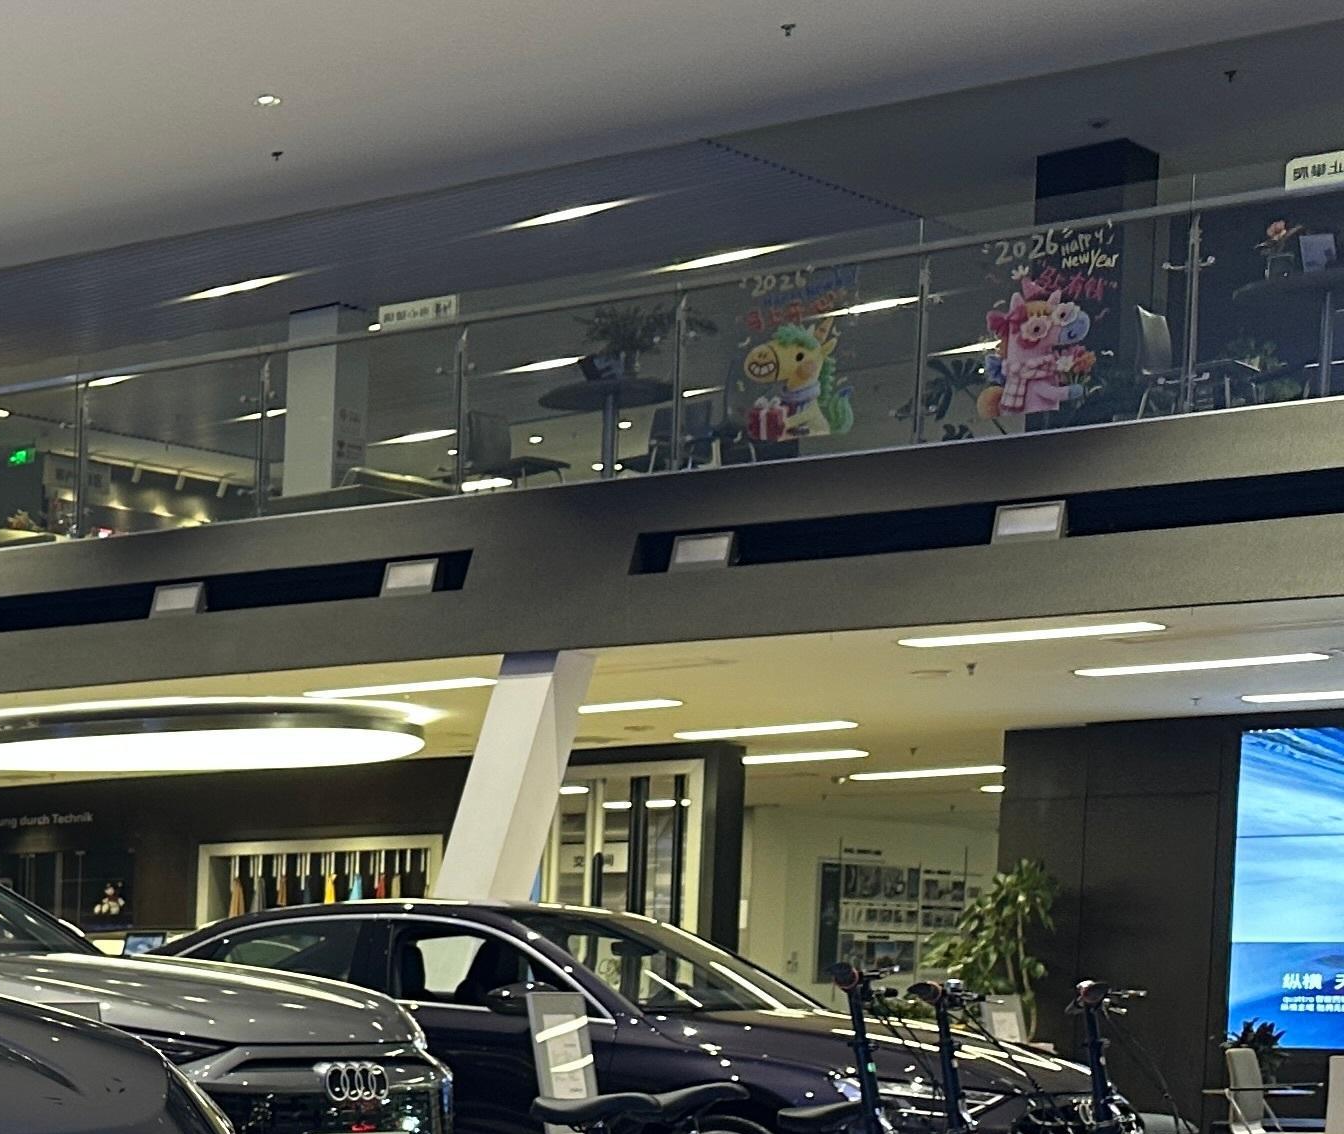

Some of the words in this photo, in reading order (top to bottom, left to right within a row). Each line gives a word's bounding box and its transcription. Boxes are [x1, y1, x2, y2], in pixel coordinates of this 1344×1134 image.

[995, 229, 1058, 265] 2026
[1087, 248, 1119, 276] Year
[750, 270, 808, 298] 2026
[19, 815, 50, 826] durch
[52, 812, 93, 825] Technik
[1282, 972, 1322, 989] 纵横
